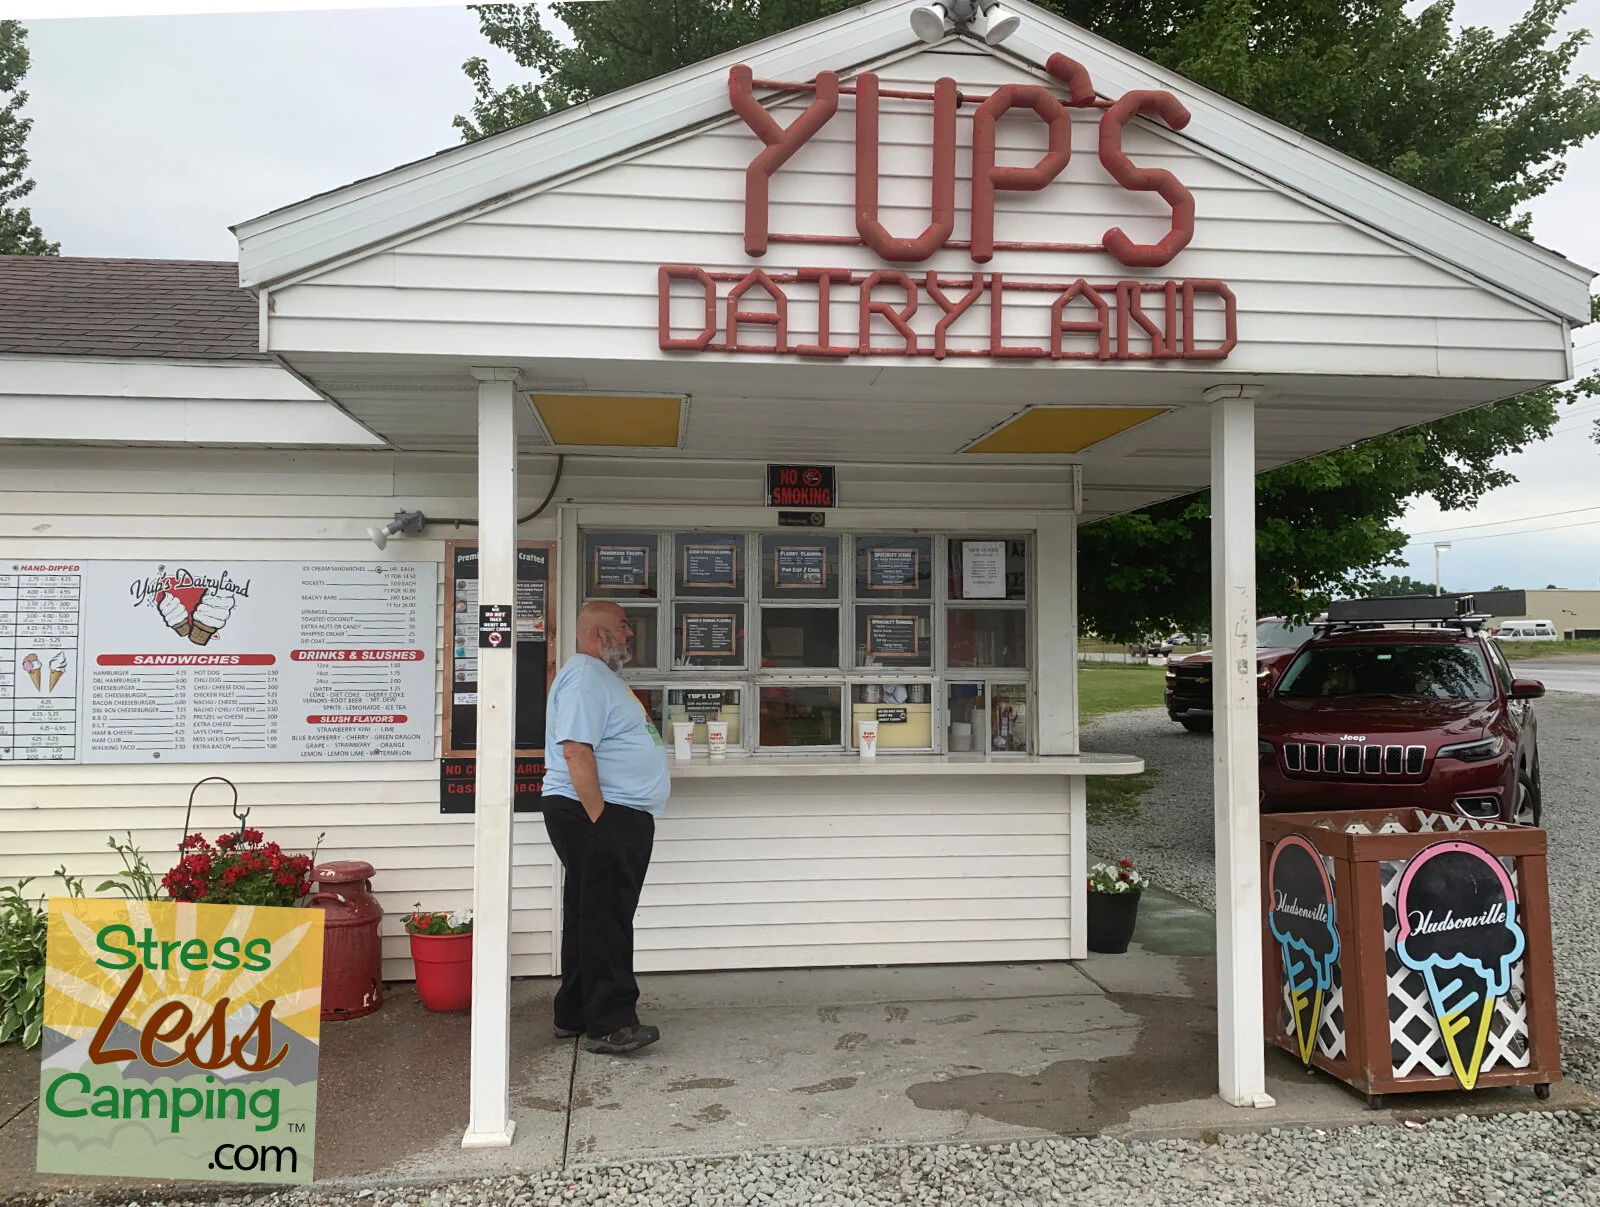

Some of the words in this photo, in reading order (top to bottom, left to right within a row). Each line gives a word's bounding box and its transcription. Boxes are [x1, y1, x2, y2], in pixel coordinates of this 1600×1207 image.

[728, 51, 1196, 268] YUP'S
[658, 264, 1238, 361] DAIRYLAND
[780, 469, 798, 485] NO
[773, 487, 831, 505] SMOKING
[518, 552, 545, 564] Crafted
[130, 572, 171, 608] Yup's
[175, 568, 251, 598] Dairyland
[133, 655, 240, 665] SANDWICHES
[298, 651, 345, 660] DRINKS
[349, 651, 357, 660] &
[361, 651, 417, 660] SLUSHES
[352, 715, 394, 723] FLAVORS
[1340, 734, 1366, 742] Jeep
[445, 765, 462, 775] NO
[514, 764, 548, 774] ARDS
[1273, 888, 1328, 923] Hudsonville
[1407, 903, 1507, 936] Hudsonville
